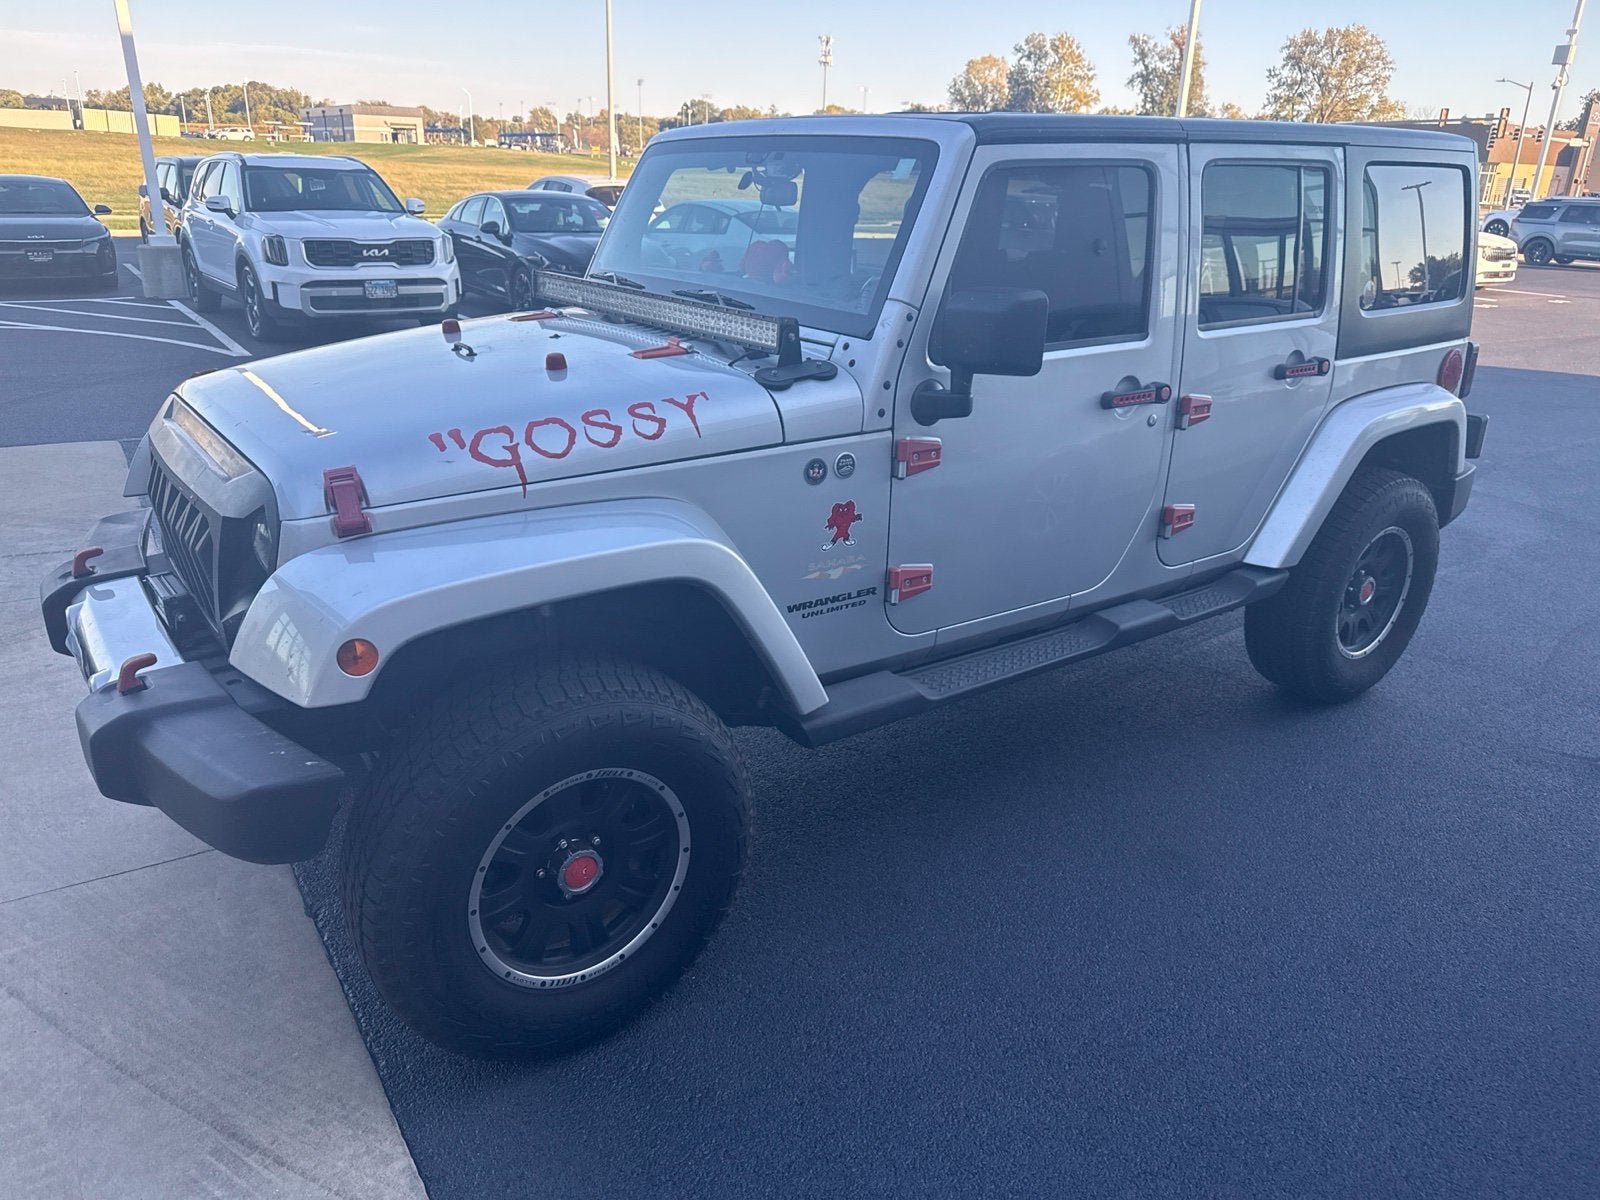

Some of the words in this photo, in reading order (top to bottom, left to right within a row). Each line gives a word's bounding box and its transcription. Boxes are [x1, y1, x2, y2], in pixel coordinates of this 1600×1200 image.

[362, 249, 389, 257] KIA
[787, 586, 878, 613] WRANGLER
[801, 599, 867, 619] UNLIMITED
